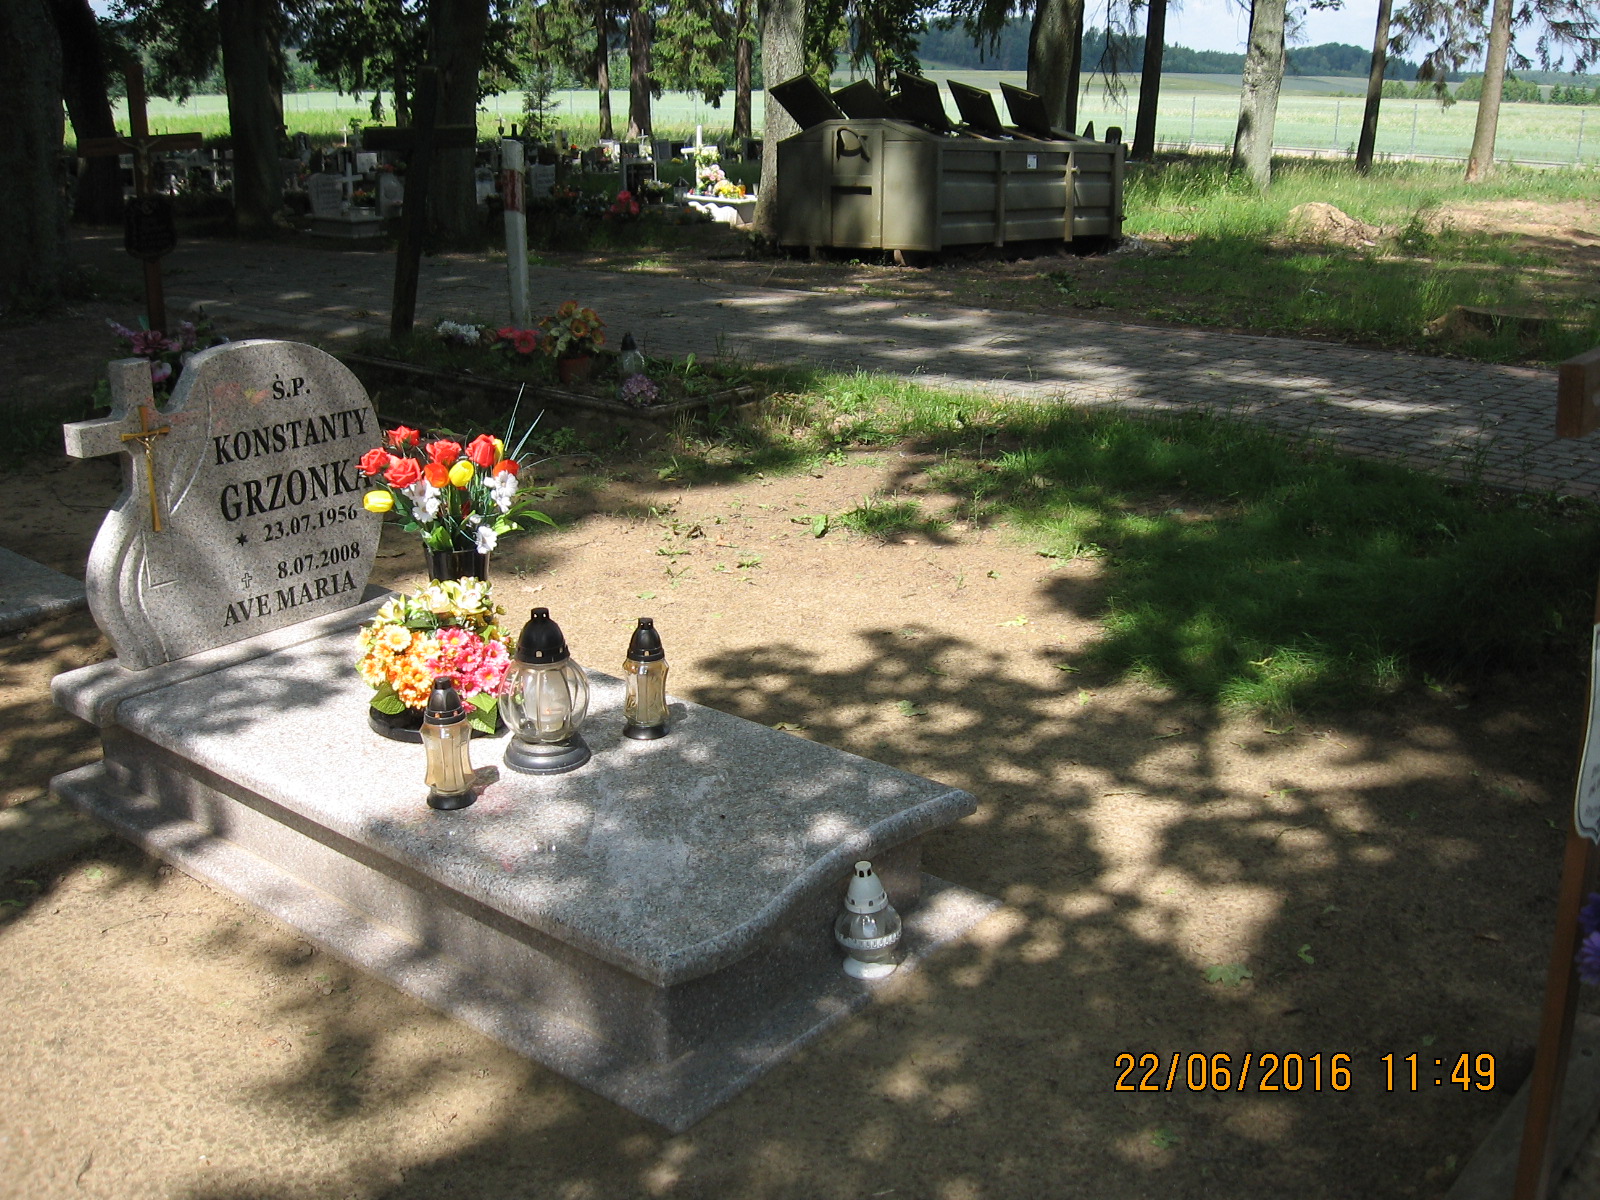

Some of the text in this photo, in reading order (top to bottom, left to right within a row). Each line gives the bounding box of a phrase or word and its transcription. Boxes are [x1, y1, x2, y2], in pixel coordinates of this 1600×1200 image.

[214, 406, 368, 465] KONSTANTY
[264, 503, 358, 542] 23.07.1956
[278, 541, 360, 579] 8.07.2008
[223, 569, 357, 628] AVE MARIA
